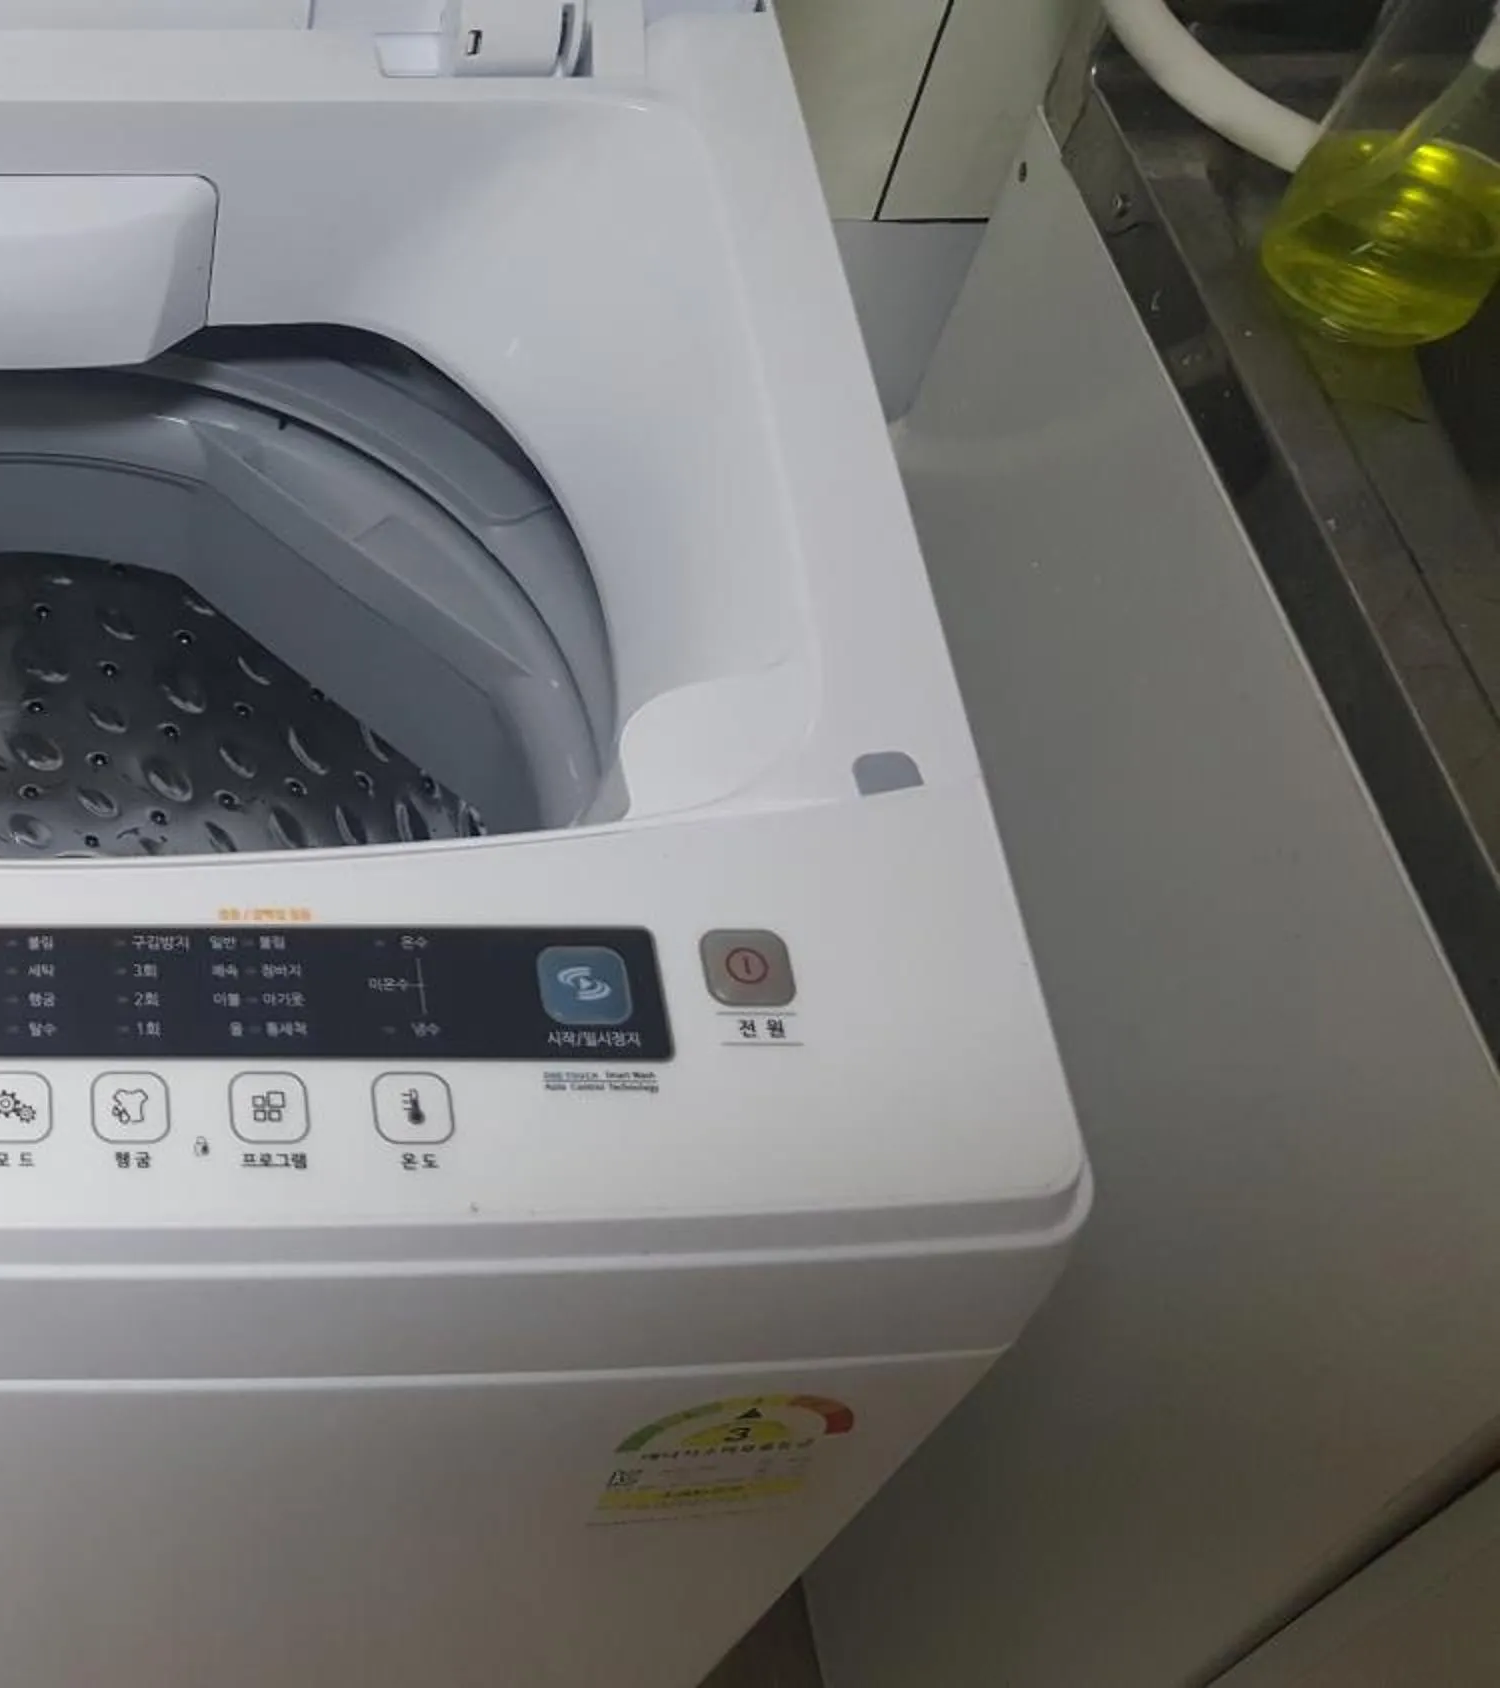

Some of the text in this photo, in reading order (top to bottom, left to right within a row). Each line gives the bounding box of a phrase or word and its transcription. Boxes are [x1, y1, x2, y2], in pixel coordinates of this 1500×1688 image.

[132, 935, 190, 952] 구김방지
[209, 935, 237, 950] 일반
[400, 935, 429, 951] 온수
[28, 964, 55, 979] 세탁
[133, 963, 158, 979] 3회
[368, 977, 408, 992] 미온수
[28, 993, 55, 1008] 헹굼
[133, 991, 160, 1007] 2회
[213, 992, 306, 1007] 이불 아기옷
[28, 1022, 57, 1037] 탈수
[136, 1021, 161, 1037] 1회
[411, 1022, 442, 1037] 냉수
[548, 1031, 642, 1047] 시작/일시정지
[241, 1152, 307, 1170] 프로그램
[724, 1426, 752, 1442] 3
